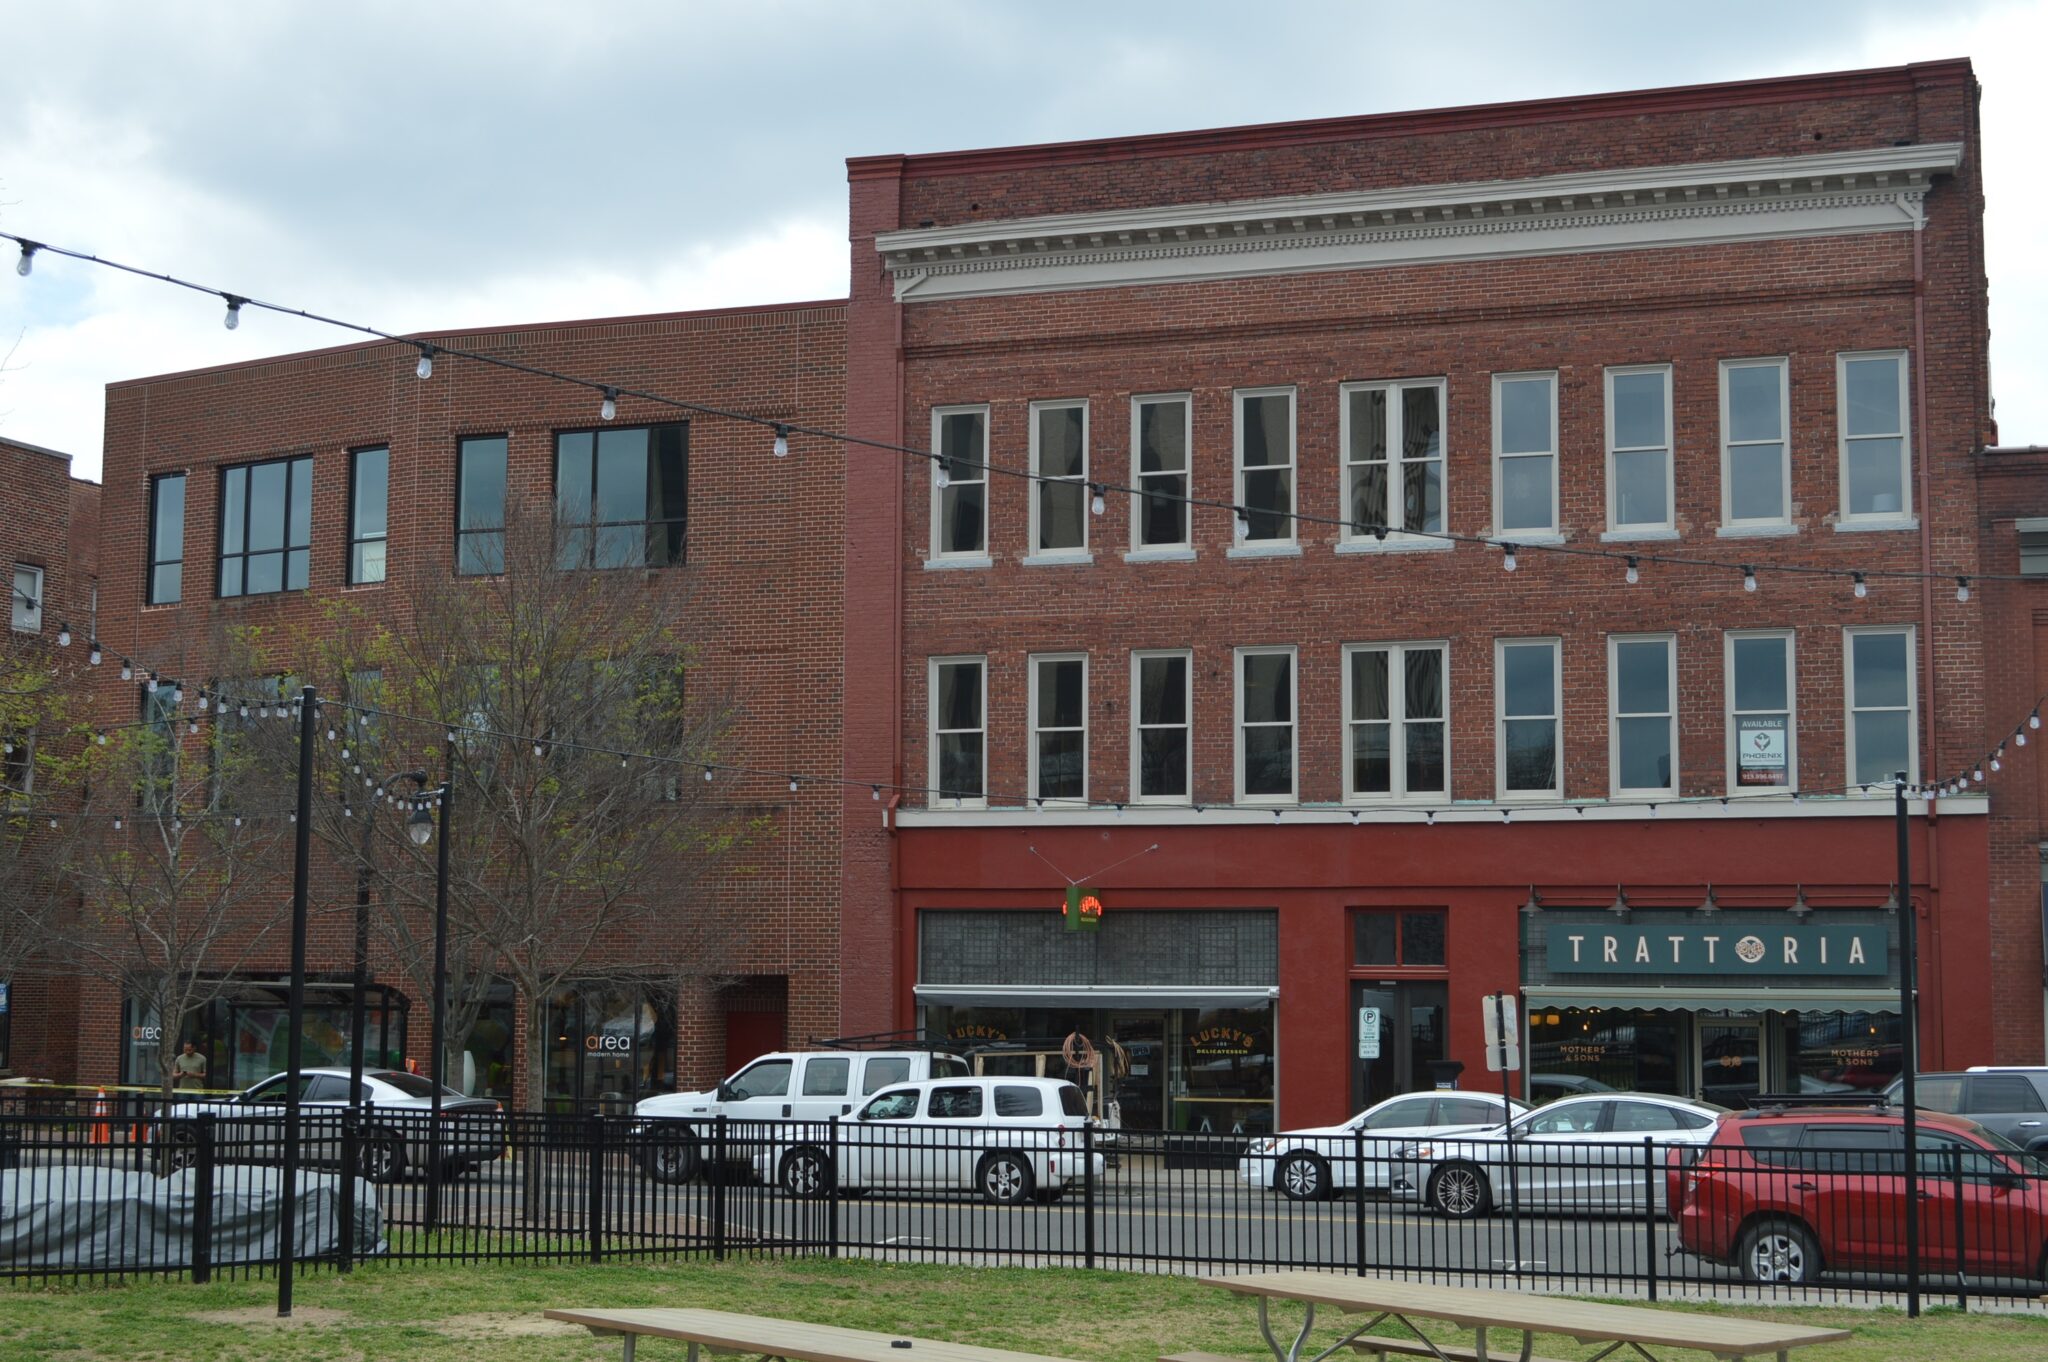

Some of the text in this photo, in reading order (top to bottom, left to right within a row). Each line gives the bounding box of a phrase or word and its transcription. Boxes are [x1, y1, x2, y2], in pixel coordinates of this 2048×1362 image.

[1742, 720, 1782, 728] AVAILABLE
[1568, 935, 1865, 964] TRATTORIA
[1367, 1012, 1374, 1021] P
[586, 1035, 630, 1050] area
[1189, 1026, 1254, 1048] LUCKY'S
[1560, 1045, 1606, 1053] MOTHERS
